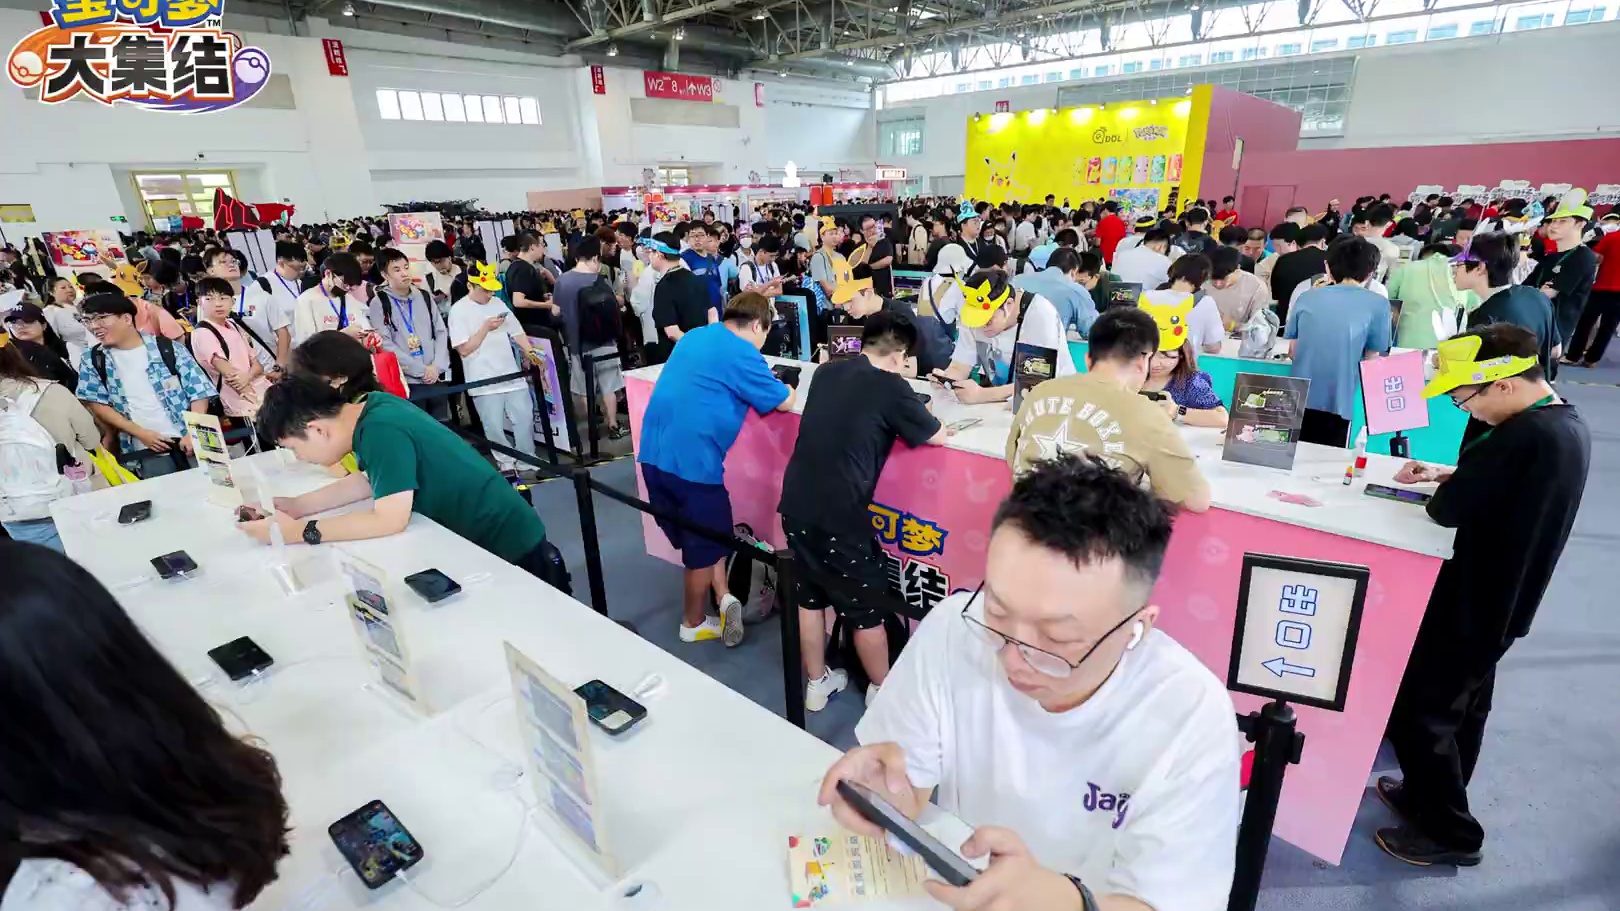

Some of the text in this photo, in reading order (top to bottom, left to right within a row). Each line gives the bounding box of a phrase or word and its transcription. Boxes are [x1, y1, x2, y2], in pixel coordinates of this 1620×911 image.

[647, 77, 664, 91] W2
[671, 80, 678, 92] 8
[697, 83, 711, 97] W3
[1384, 376, 1405, 412] 出口
[1275, 584, 1318, 650] 出口
